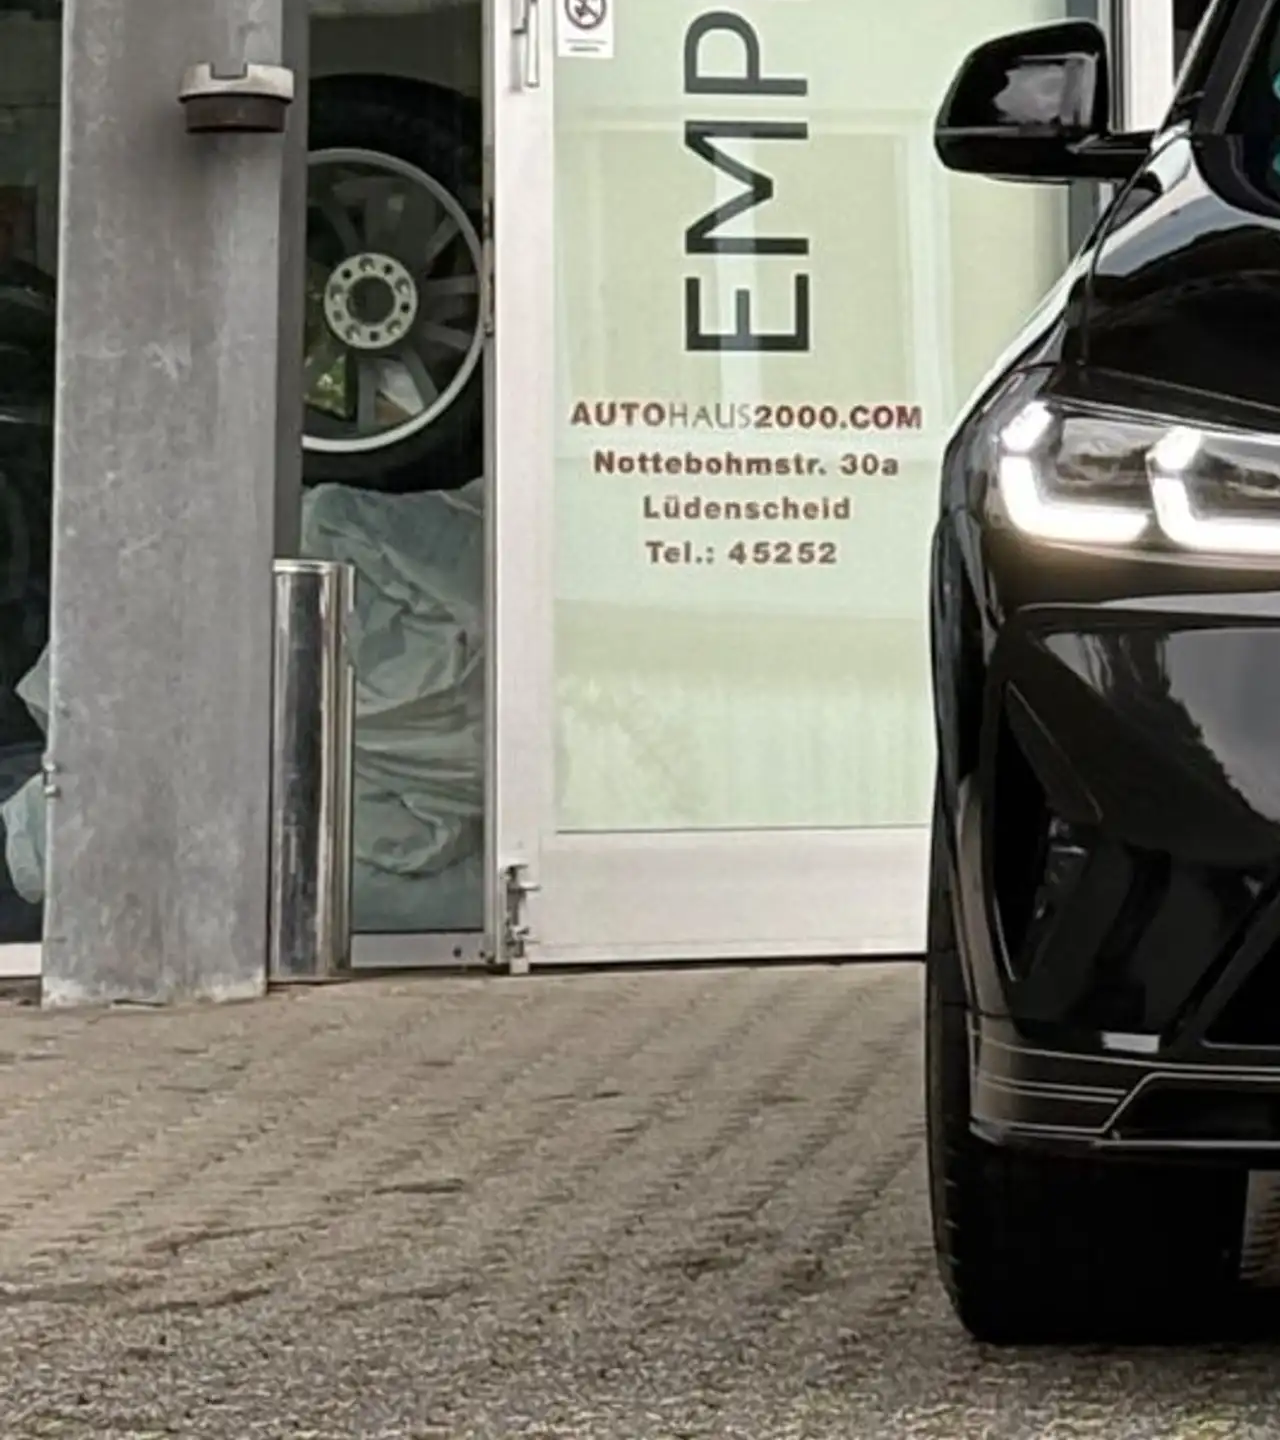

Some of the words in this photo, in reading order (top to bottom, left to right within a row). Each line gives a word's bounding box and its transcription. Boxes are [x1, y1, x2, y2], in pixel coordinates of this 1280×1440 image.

[570, 403, 922, 430] AUTOHAUS2000.COM
[594, 451, 827, 476] Nottebohmstr.
[840, 454, 899, 476] 30a
[643, 496, 851, 520] Lüdenscheid
[646, 542, 714, 565] Tel.:
[727, 542, 838, 565] 45252
